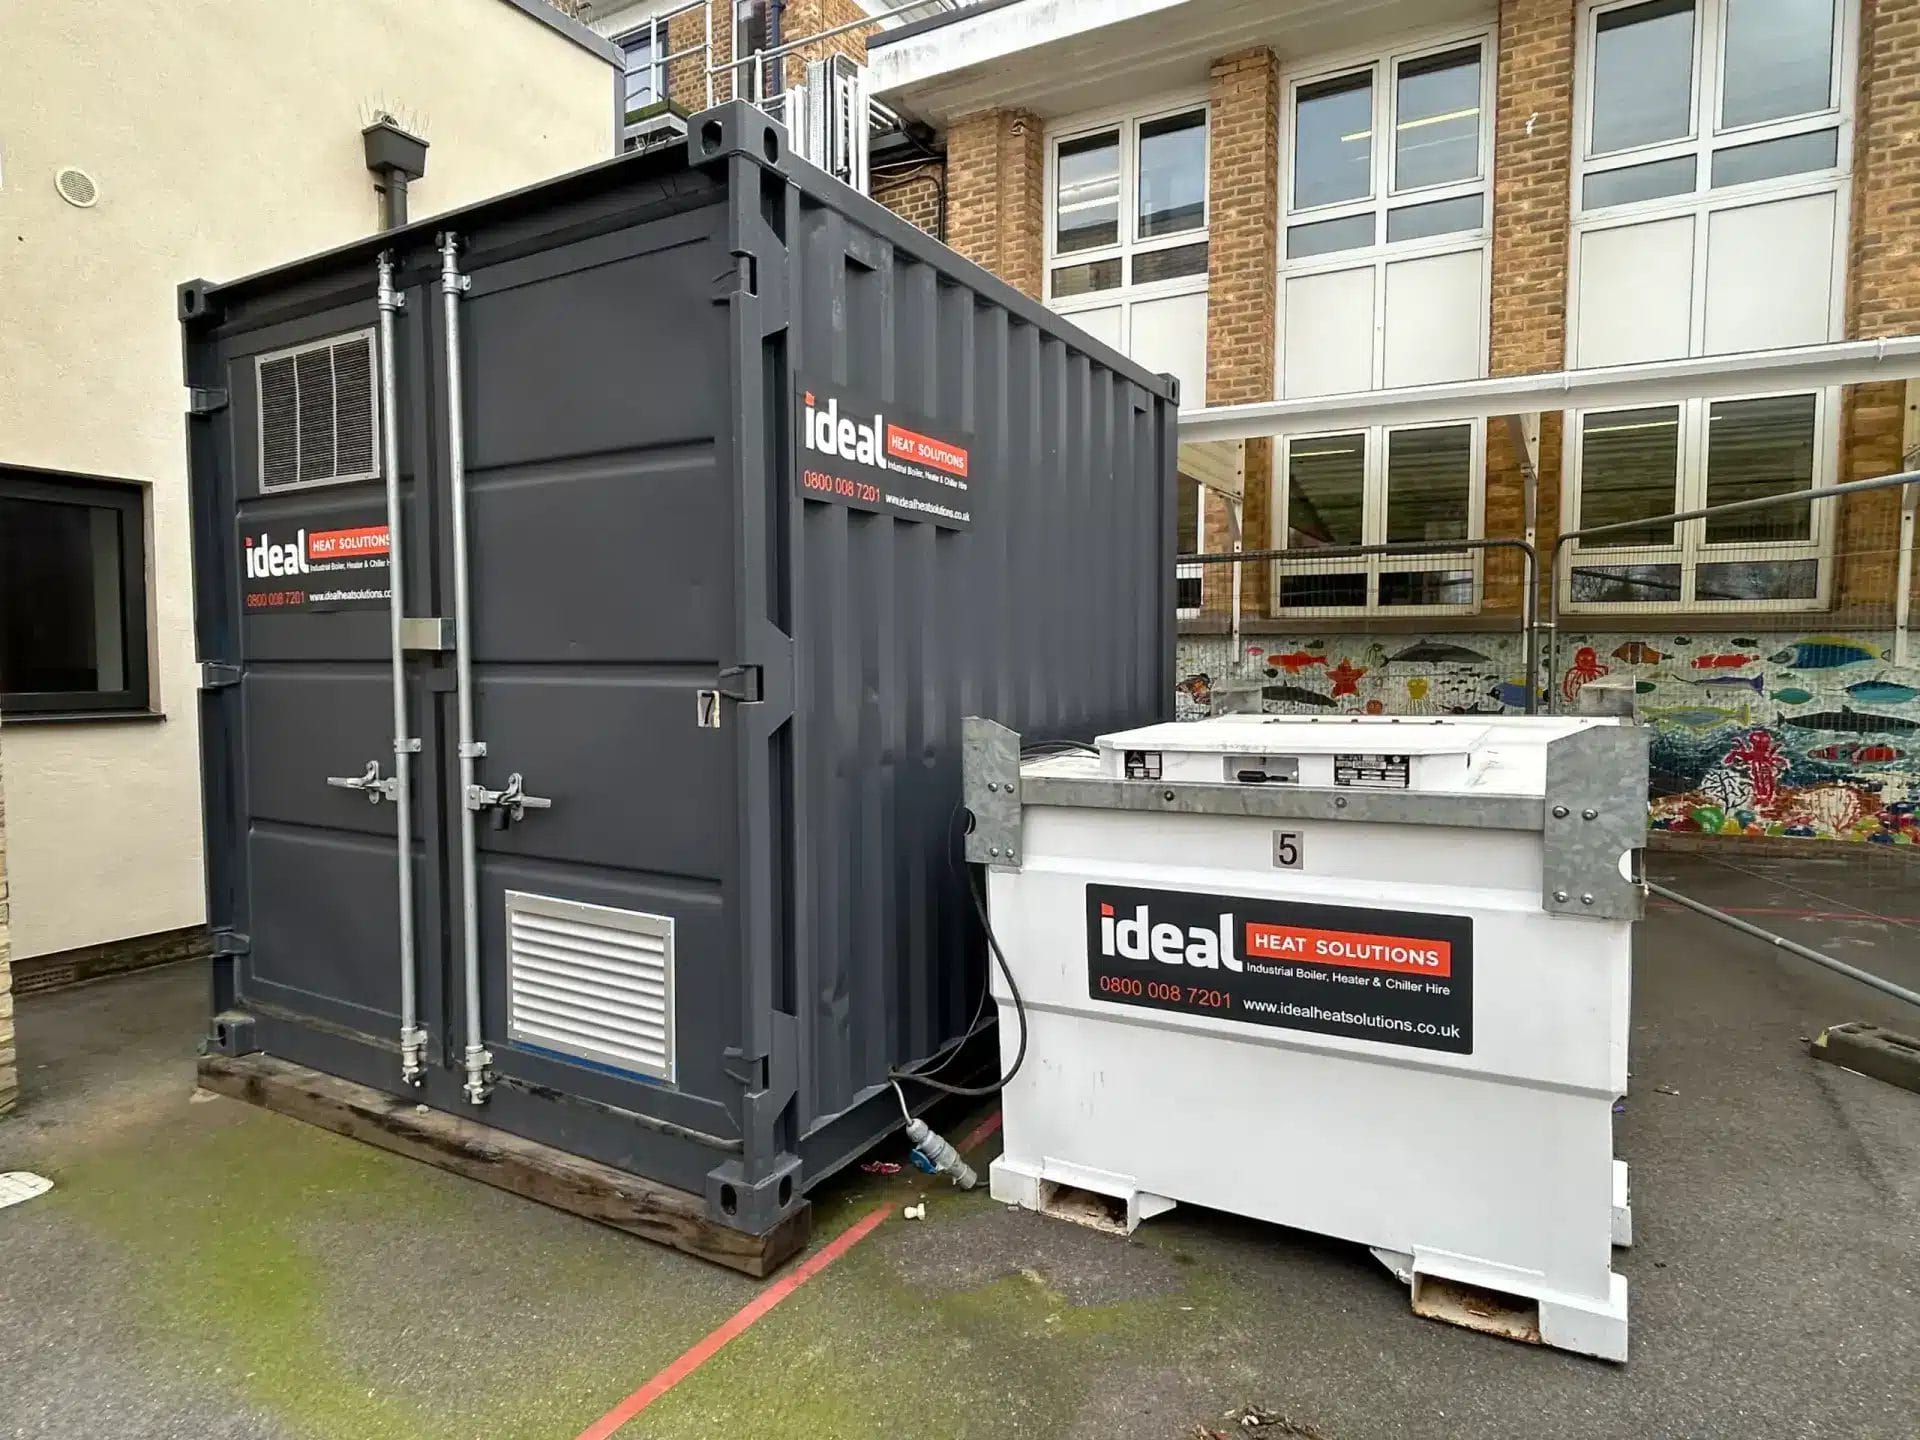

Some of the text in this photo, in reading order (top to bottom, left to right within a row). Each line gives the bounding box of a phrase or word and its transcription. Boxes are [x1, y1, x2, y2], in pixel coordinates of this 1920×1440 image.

[804, 391, 887, 469] ideal
[891, 434, 964, 468] HEAT SOLUTIONS
[804, 469, 880, 502] 0800 008 7201
[245, 528, 309, 578] ideal
[312, 534, 390, 552] HEAT SOLUTIONS
[285, 591, 305, 604] 7201
[309, 589, 392, 602] www.idealheatsolutions.co
[702, 693, 715, 724] 7
[1279, 833, 1297, 865] 5
[1101, 903, 1243, 973] ideal
[1255, 933, 1440, 967] HEAT SOLUTIONS
[1100, 975, 1232, 1009] 0800 008 7201
[1247, 962, 1451, 995] Industrial Boiler, Heater & Chiller Hire
[1243, 999, 1461, 1039] www.idealheatsolutions.co.uk
